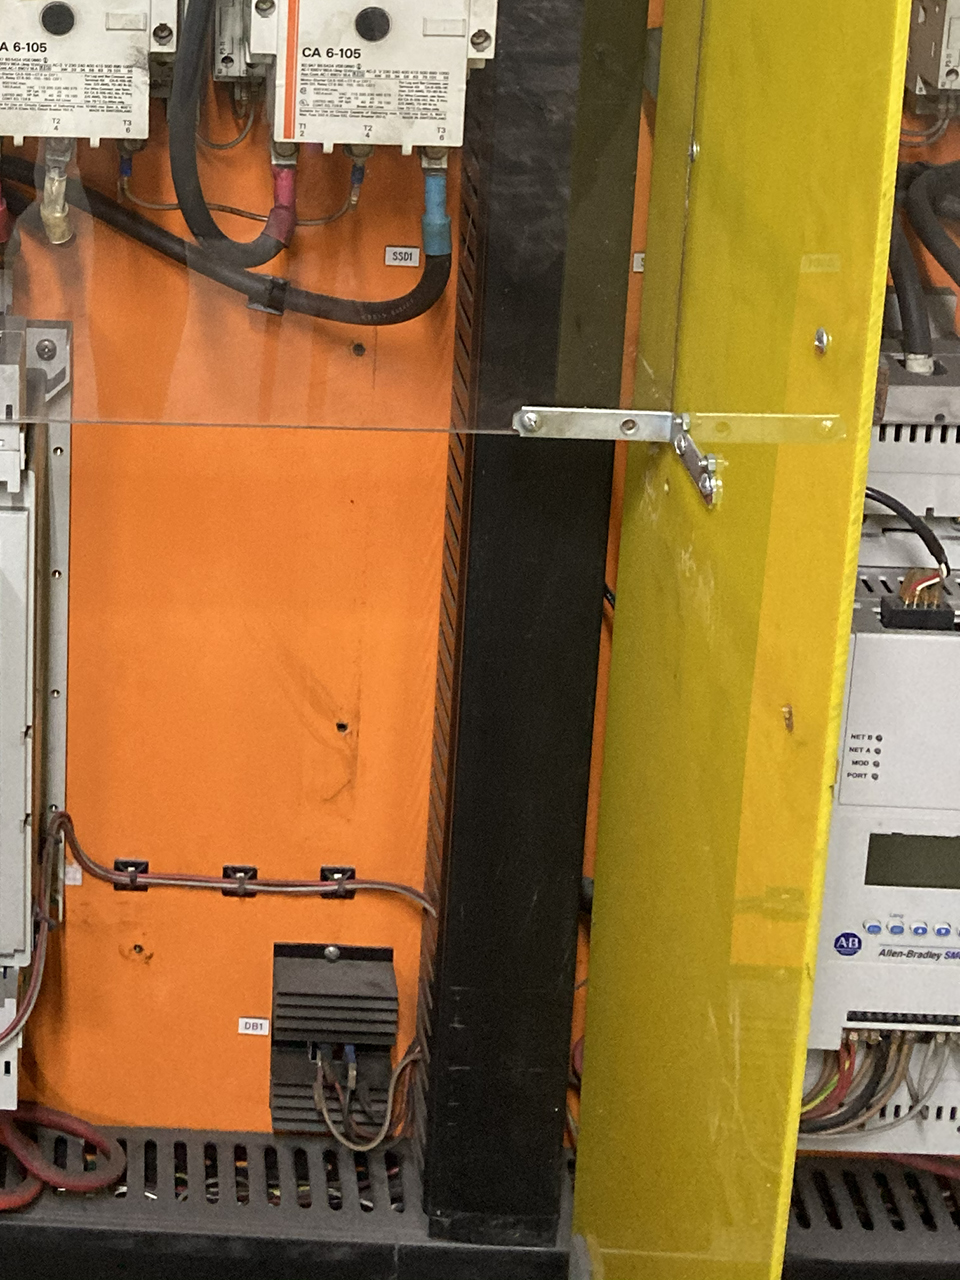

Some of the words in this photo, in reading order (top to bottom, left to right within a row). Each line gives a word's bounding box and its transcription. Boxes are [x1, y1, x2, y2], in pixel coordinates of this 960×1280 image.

[13, 42, 48, 52] 6-105
[302, 48, 322, 59] CA
[326, 48, 362, 60] 6-105
[126, 126, 130, 134] 6
[364, 124, 373, 132] T2
[436, 126, 446, 134] T3
[392, 251, 413, 262] SSD1
[836, 937, 858, 948] AB
[879, 949, 942, 962] Allen-Bradley
[244, 1022, 264, 1032] DB1
